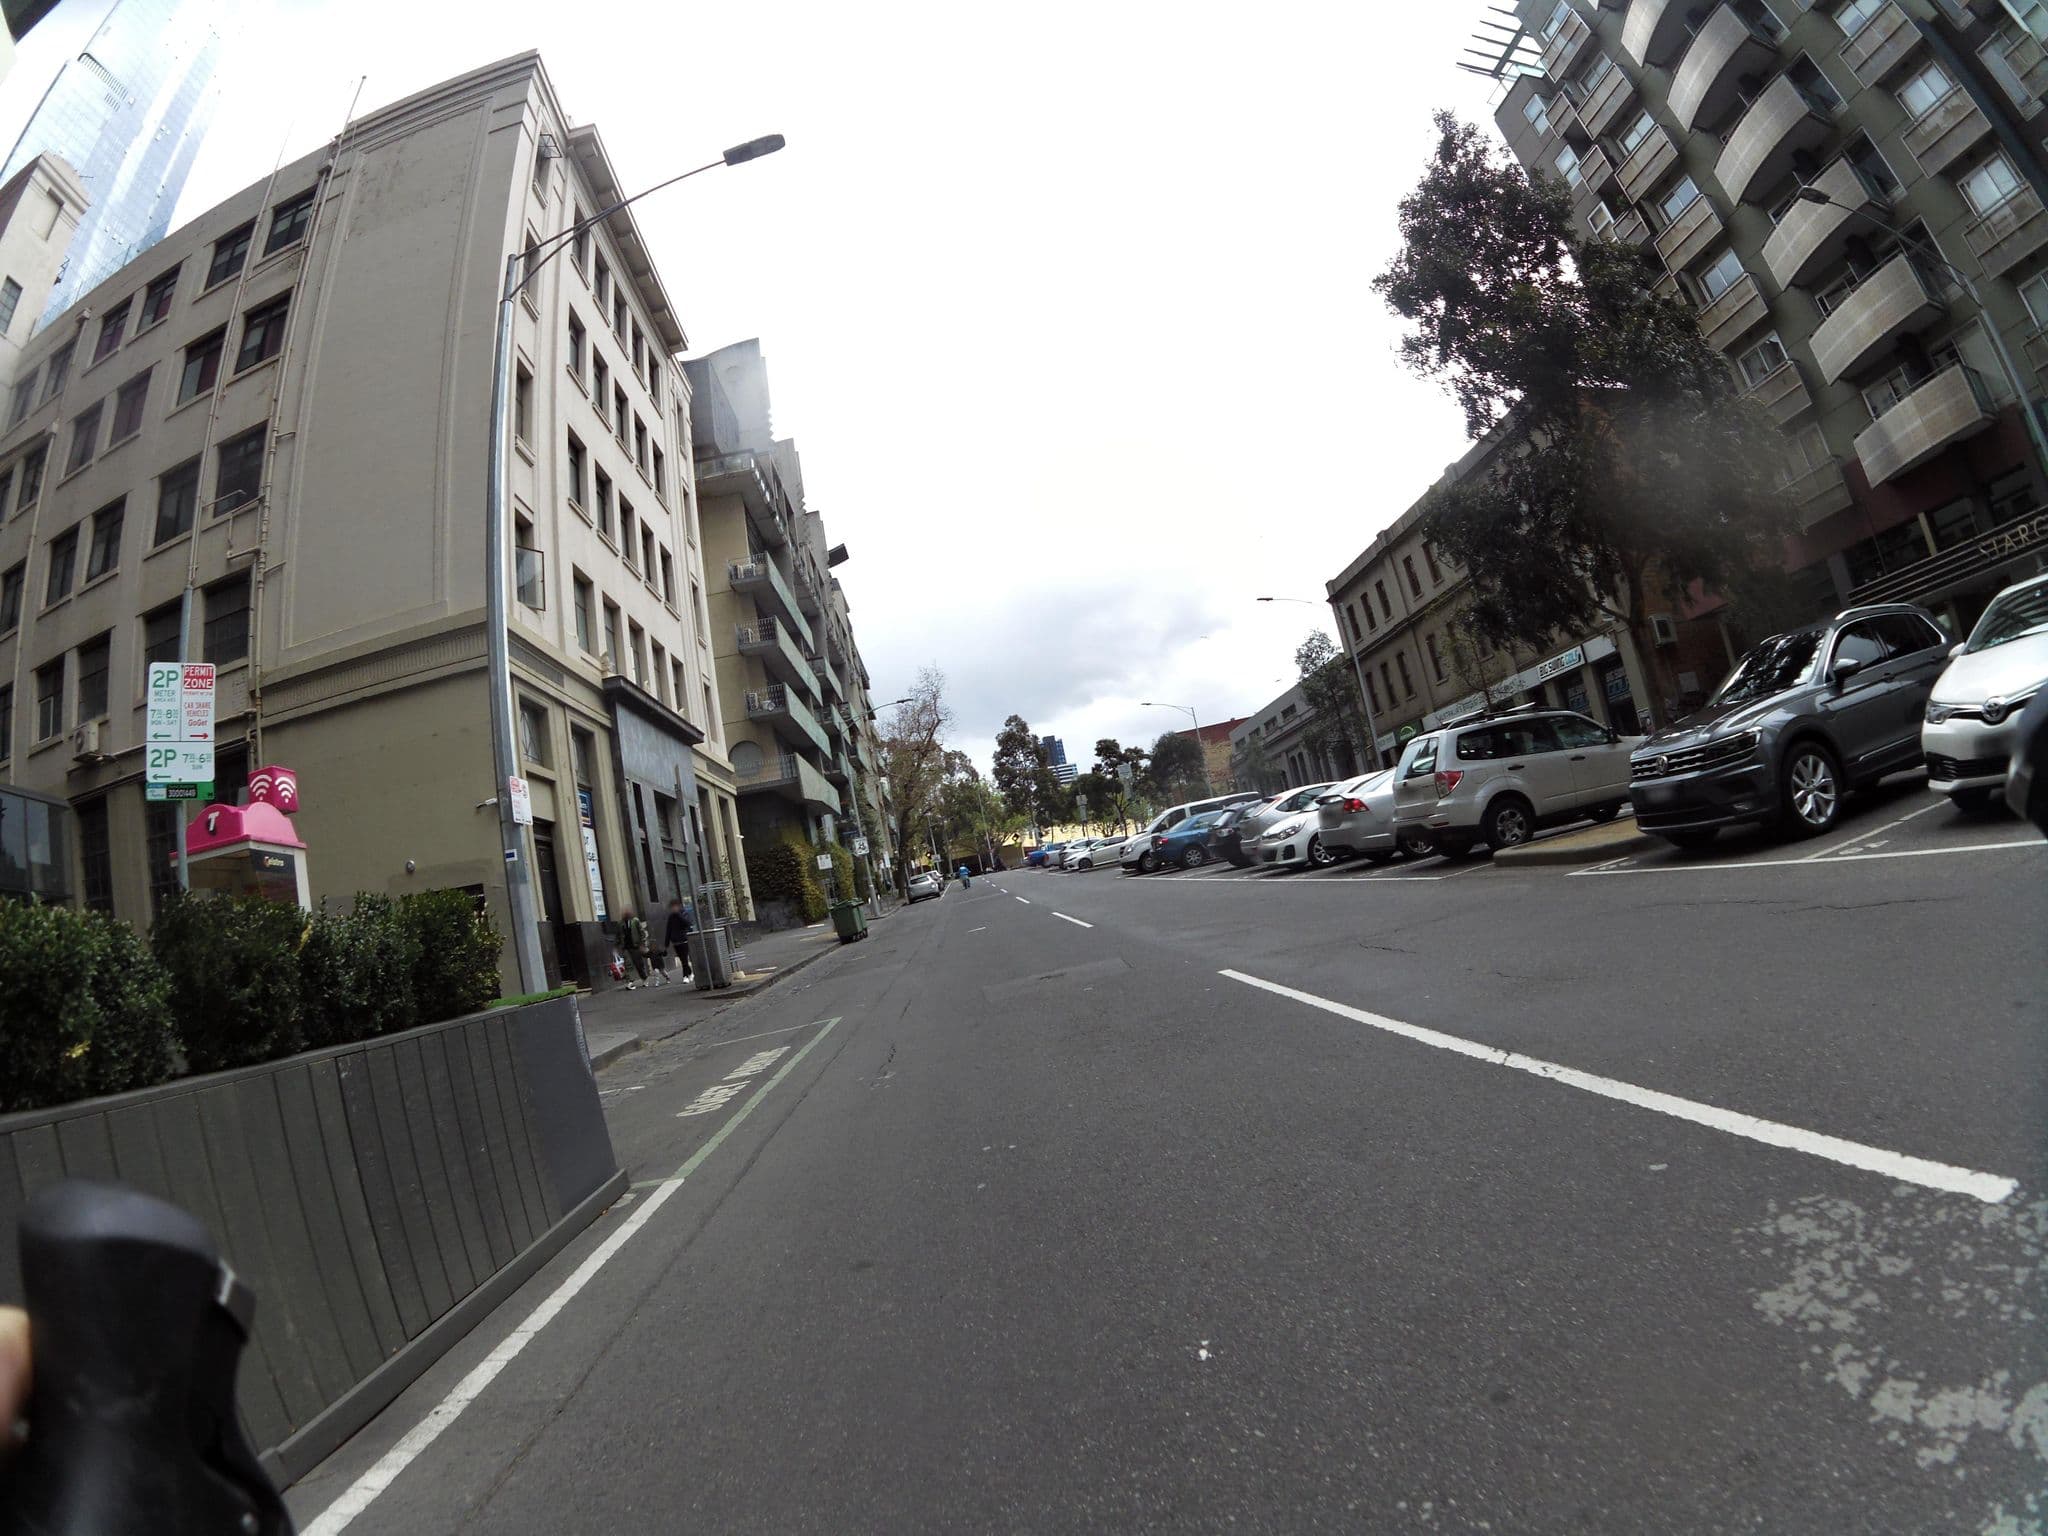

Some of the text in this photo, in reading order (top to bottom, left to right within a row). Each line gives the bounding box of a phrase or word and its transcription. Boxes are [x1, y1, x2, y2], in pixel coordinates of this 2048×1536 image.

[184, 666, 213, 677] PERMIT
[152, 669, 179, 689] 2P
[184, 678, 213, 689] ZONE
[188, 719, 208, 727] GoGet
[150, 748, 177, 768] 2P
